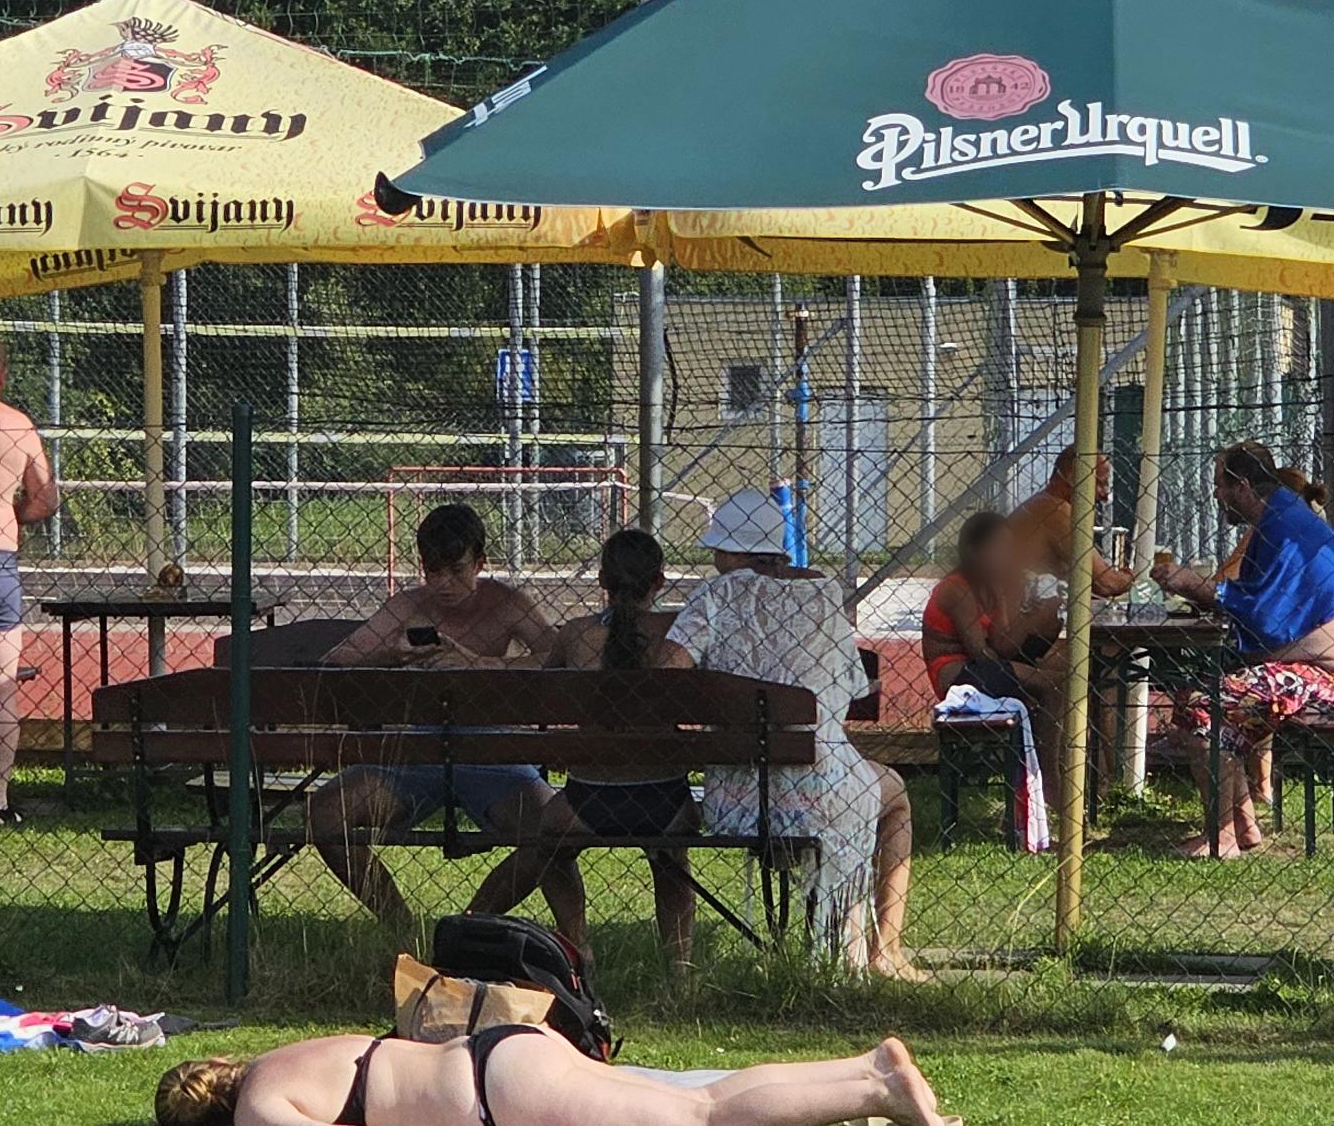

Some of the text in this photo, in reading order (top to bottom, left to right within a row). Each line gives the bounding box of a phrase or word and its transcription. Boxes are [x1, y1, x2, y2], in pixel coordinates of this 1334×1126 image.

[143, 139, 244, 154] pivovar
[856, 99, 1251, 193] Pilsner Urquell
[113, 181, 295, 233] Svijany
